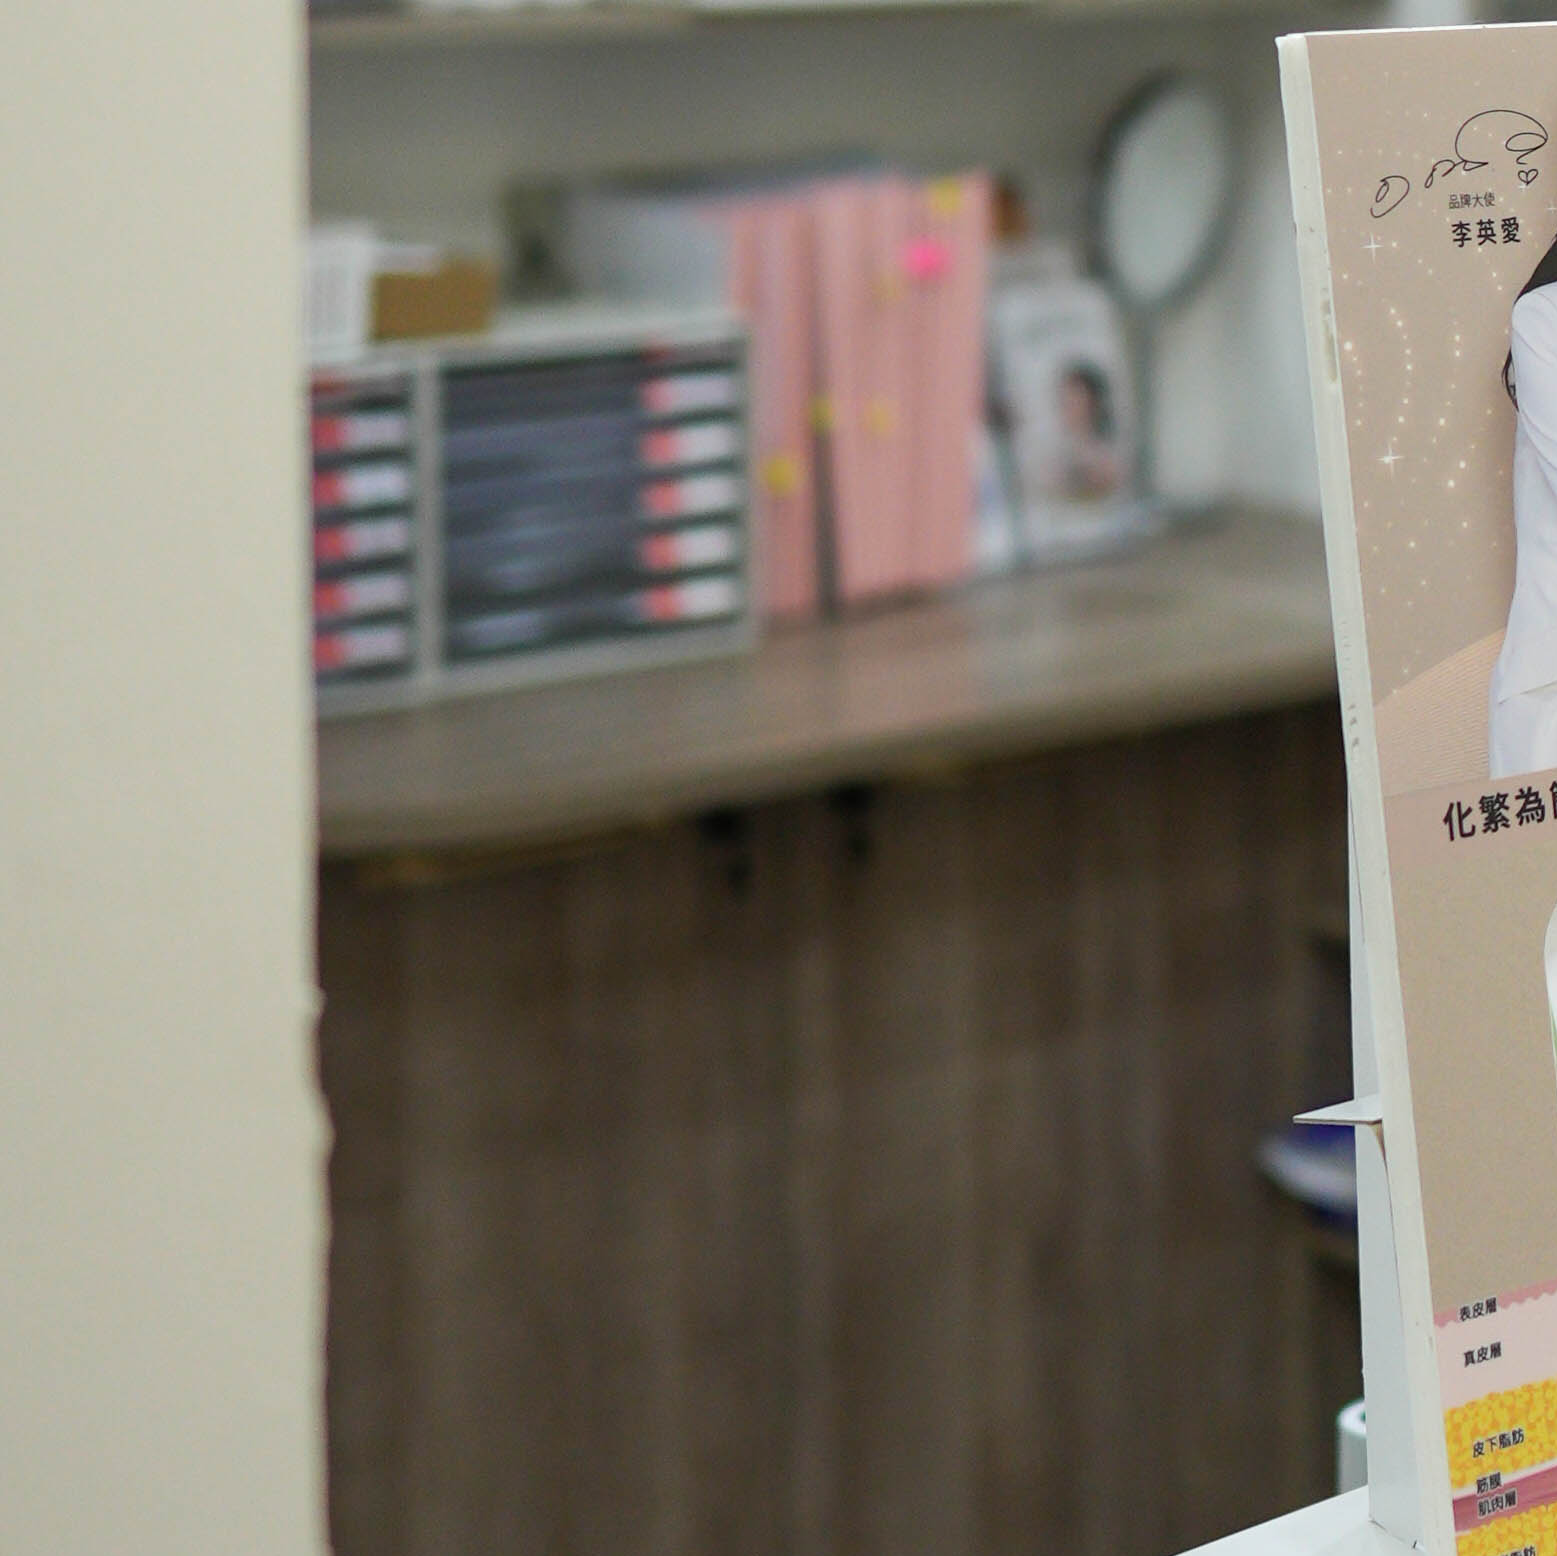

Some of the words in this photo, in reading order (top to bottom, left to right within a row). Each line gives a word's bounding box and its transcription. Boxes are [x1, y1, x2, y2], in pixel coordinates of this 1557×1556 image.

[1449, 192, 1496, 209] 品牌大使
[1452, 216, 1521, 248] 李英愛
[1459, 1296, 1497, 1322] 表皮層
[1463, 1341, 1501, 1368] 真皮層
[1472, 1428, 1525, 1458] 皮下脂肪
